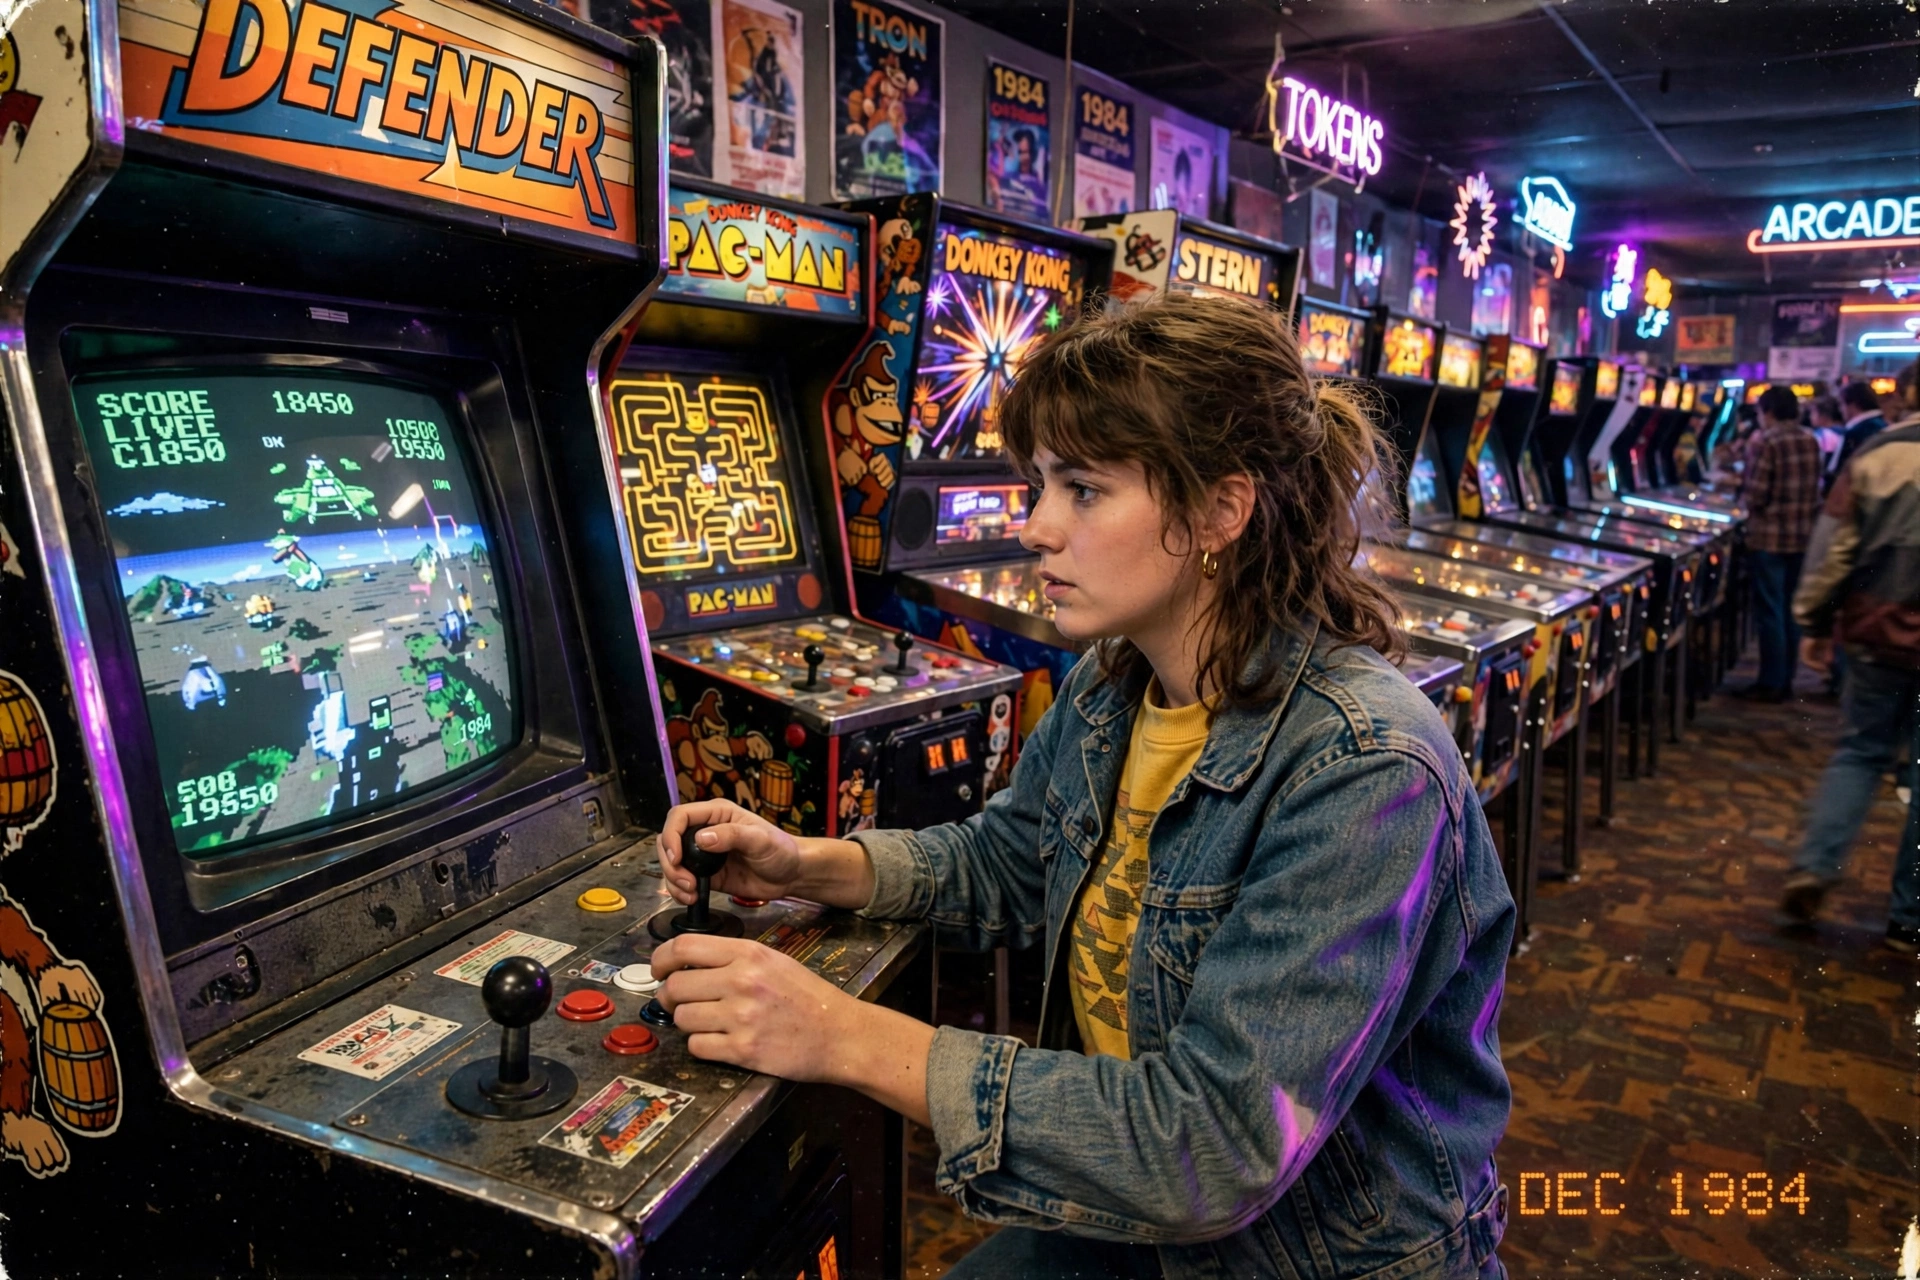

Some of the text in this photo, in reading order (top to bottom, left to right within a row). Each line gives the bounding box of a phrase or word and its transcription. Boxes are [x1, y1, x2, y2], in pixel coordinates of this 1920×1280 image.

[851, 1, 928, 61] TRON
[181, 0, 613, 227] DEFENDER
[993, 67, 1045, 108] 1984
[1081, 92, 1129, 137] 1984
[1283, 77, 1384, 176] TOKENS
[1762, 196, 1920, 243] ARCADE
[669, 218, 847, 294] PAC-MAN
[945, 234, 1070, 293] DONKEY KONG
[1177, 237, 1262, 296] STERN
[96, 390, 214, 417] SCORE
[272, 390, 354, 415] 18450
[688, 582, 774, 614] PAC-MAN
